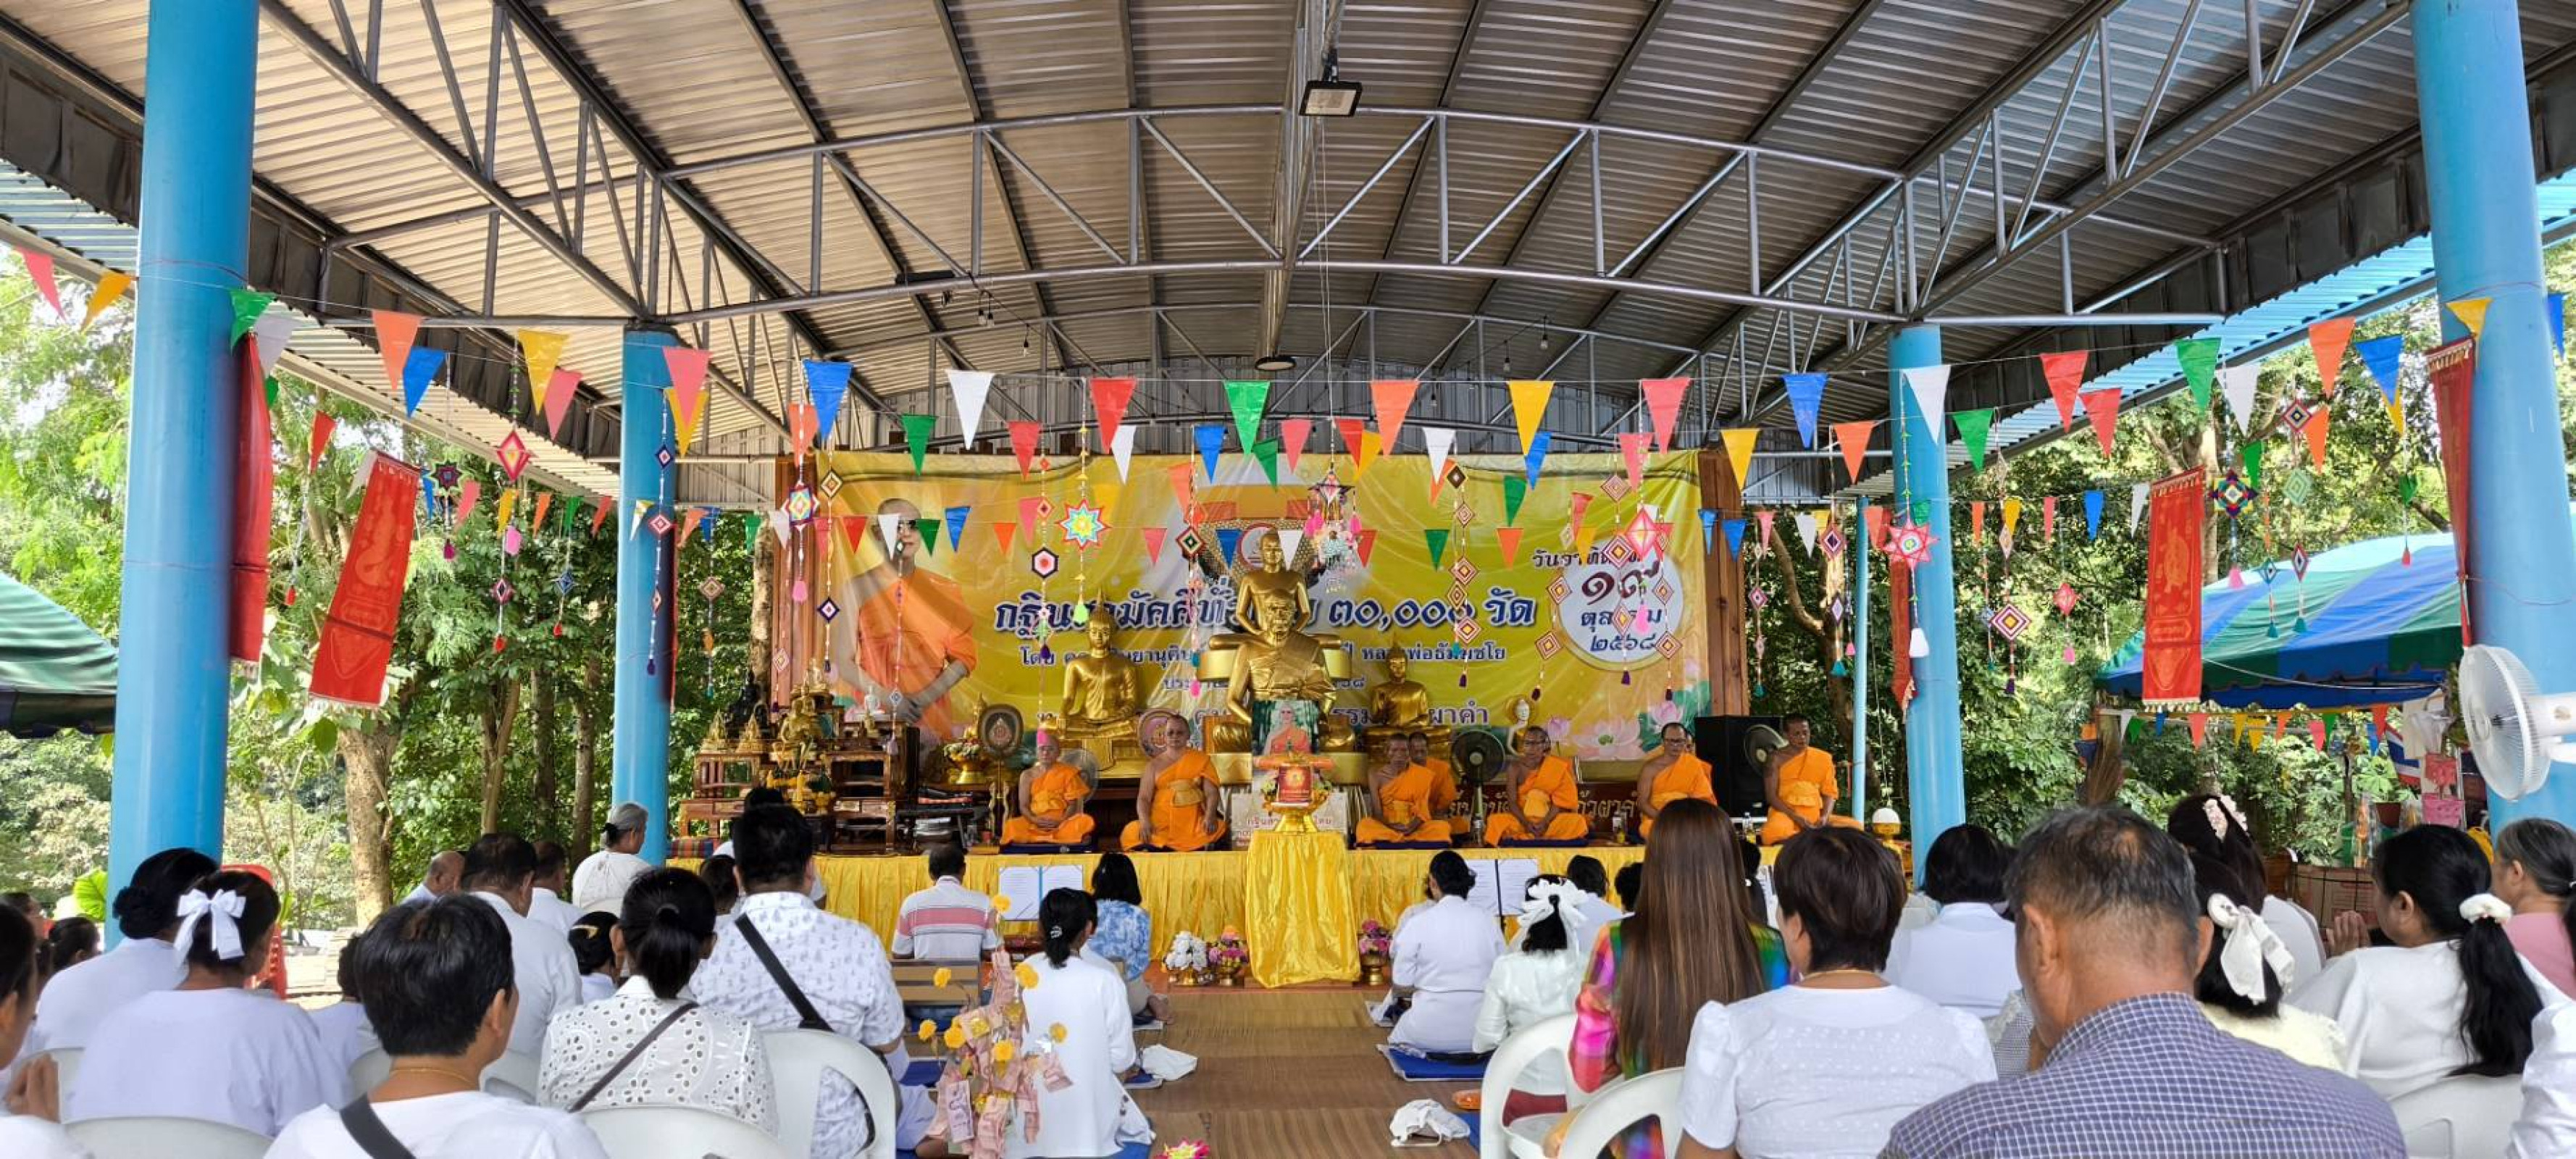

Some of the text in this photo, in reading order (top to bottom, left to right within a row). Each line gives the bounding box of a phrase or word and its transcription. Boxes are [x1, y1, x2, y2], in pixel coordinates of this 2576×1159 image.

[1581, 561, 1660, 606] ๑๙
[1486, 587, 1535, 625] วัด
[1581, 608, 1663, 632] ตุลม
